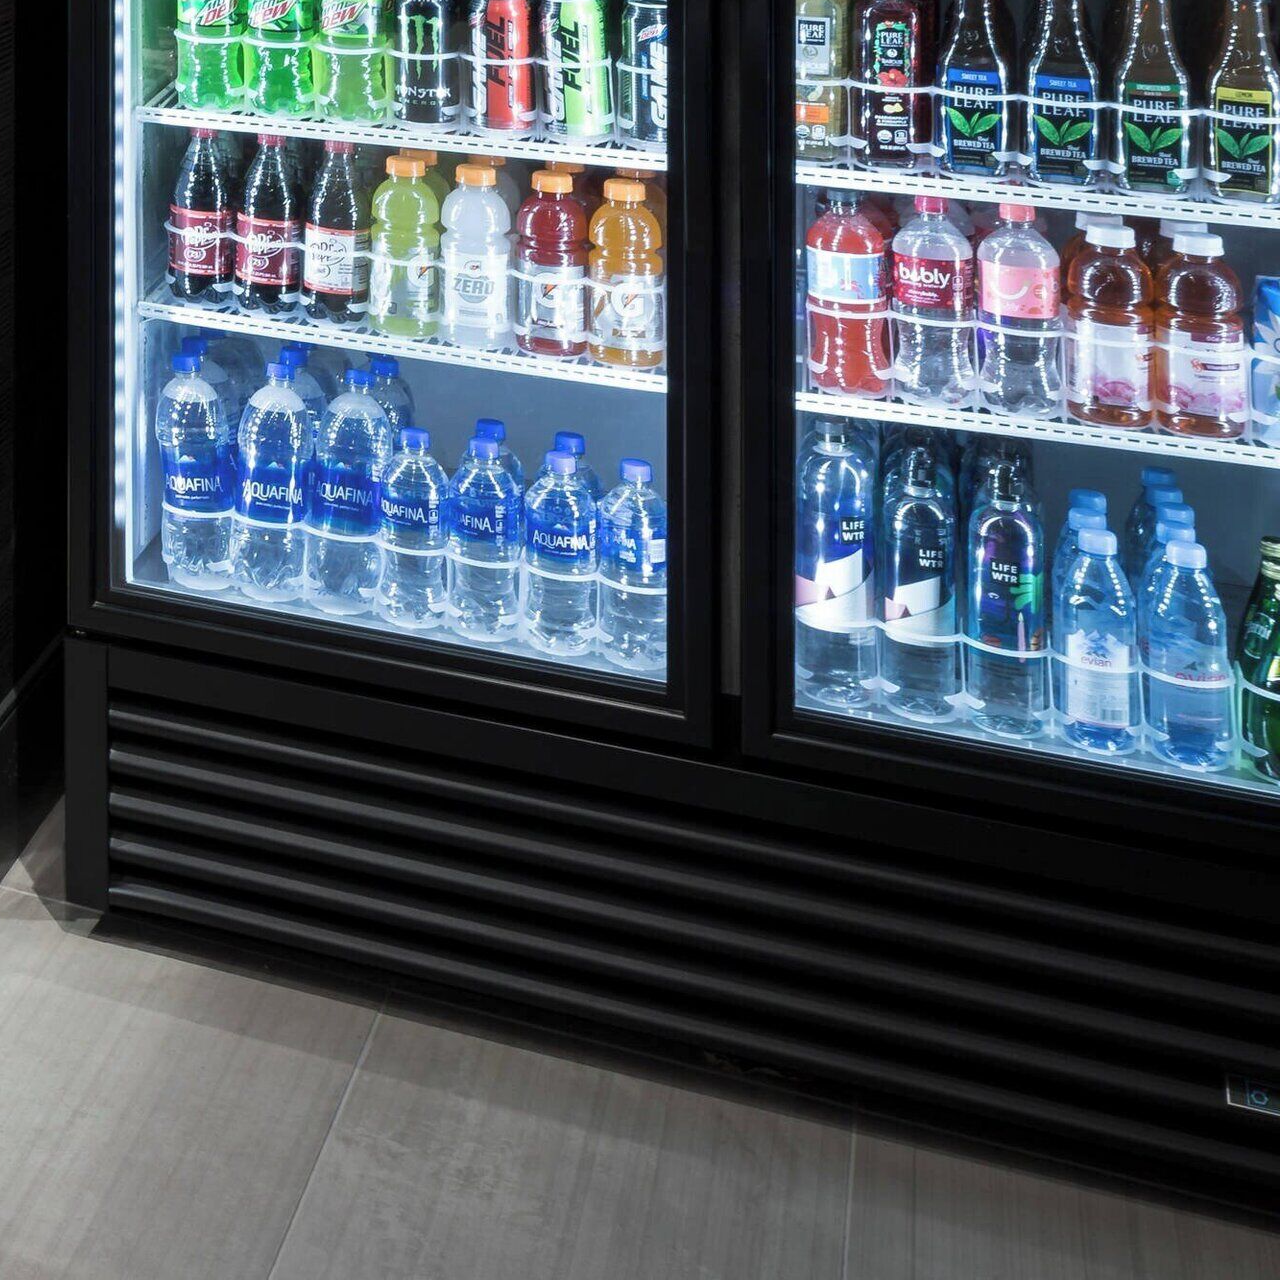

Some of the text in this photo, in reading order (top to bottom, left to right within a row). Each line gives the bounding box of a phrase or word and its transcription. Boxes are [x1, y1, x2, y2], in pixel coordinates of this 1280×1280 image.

[799, 23, 825, 33] PURE
[880, 31, 904, 41] PURE
[953, 84, 995, 97] PURE
[1042, 91, 1086, 104] PURE
[1132, 98, 1176, 111] PURE
[1222, 103, 1267, 117] PURE
[952, 138, 996, 151] BREWED TEA
[1040, 147, 1087, 160] BREWED TEA
[1130, 154, 1179, 167] BREWED TEA
[1220, 160, 1267, 173] BREWED TEA
[898, 262, 951, 290] bubly
[453, 277, 496, 296] ZERO
[165, 473, 223, 495] AQUAFINA
[242, 478, 304, 508] AQUAFINA
[316, 480, 374, 508] AQUAFINA
[842, 520, 865, 531] LIFE
[532, 528, 590, 552] AQUAFINA
[841, 531, 865, 542] WTR
[918, 548, 944, 560] LIFE
[918, 557, 944, 569] WTR
[991, 562, 1018, 574] LIFE
[991, 571, 1018, 584] WTR
[1080, 654, 1113, 668] evian
